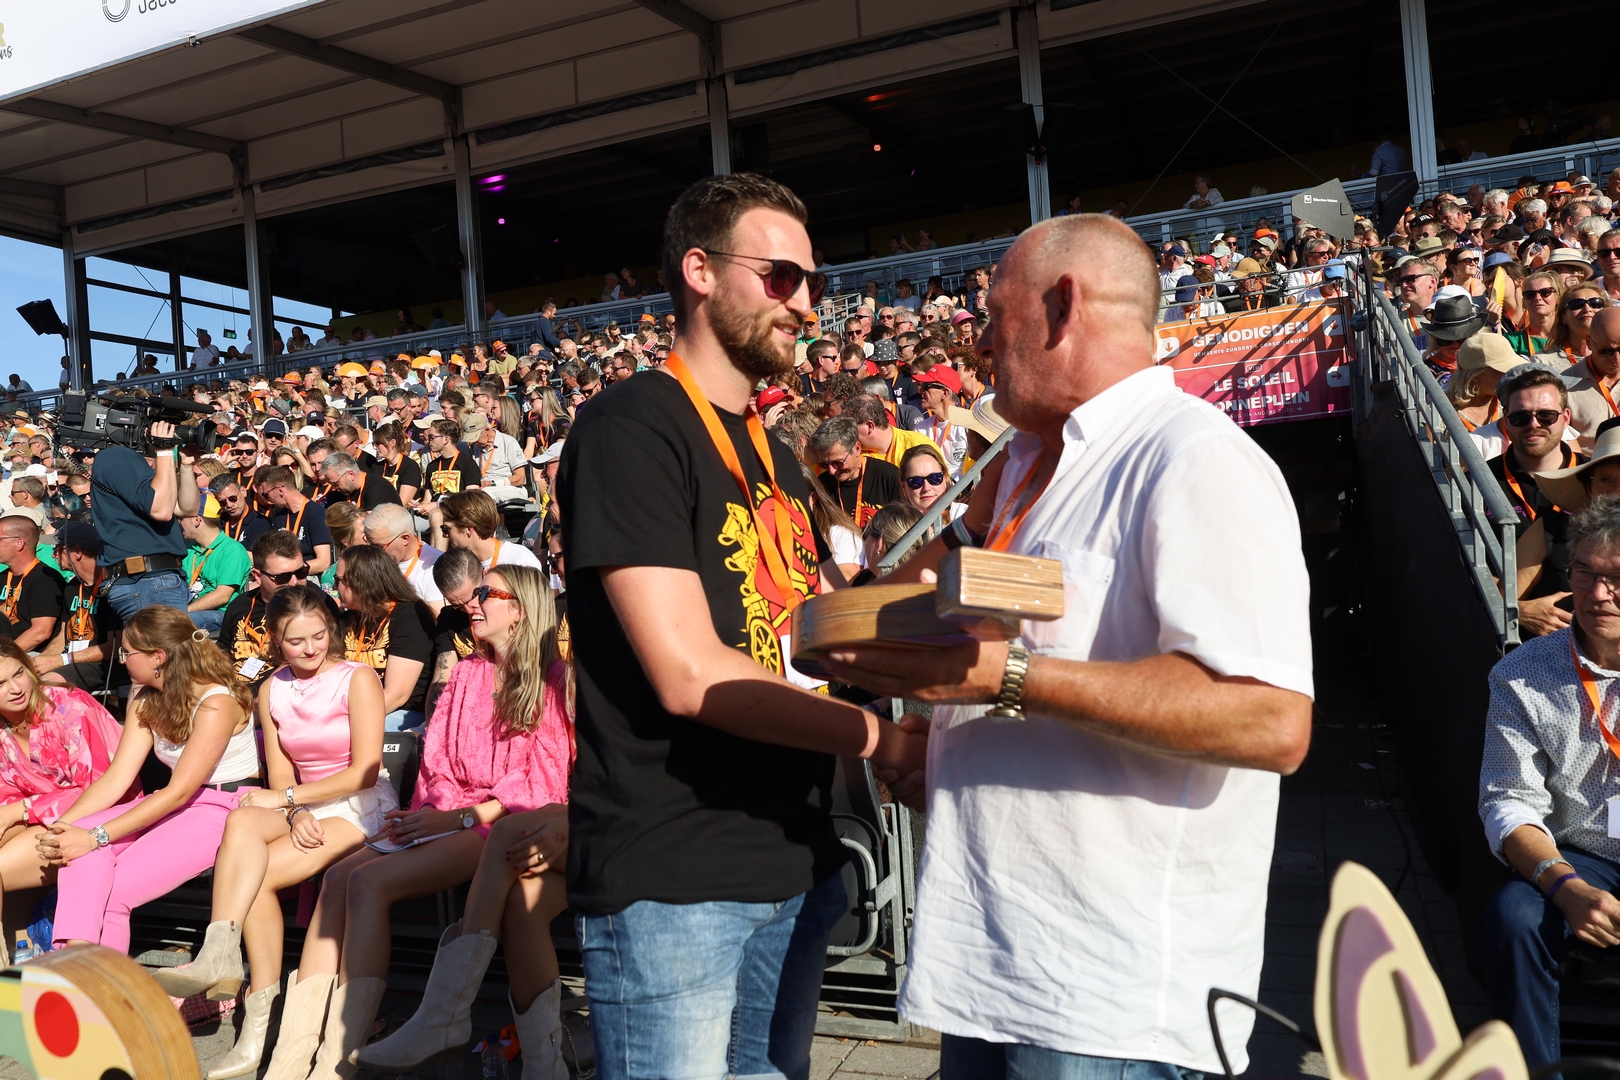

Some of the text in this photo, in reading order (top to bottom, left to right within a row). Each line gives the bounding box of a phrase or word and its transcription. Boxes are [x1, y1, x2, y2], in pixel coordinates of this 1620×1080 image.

[1192, 319, 1309, 348] GENODIGDEN
[1194, 349, 1224, 357] GEMEENTE
[1225, 345, 1253, 353] ZUNDERT
[1282, 337, 1309, 345] ZUNDERT
[1214, 371, 1296, 392] LE SOLEIL
[1208, 390, 1310, 413] ONNEPLEIN
